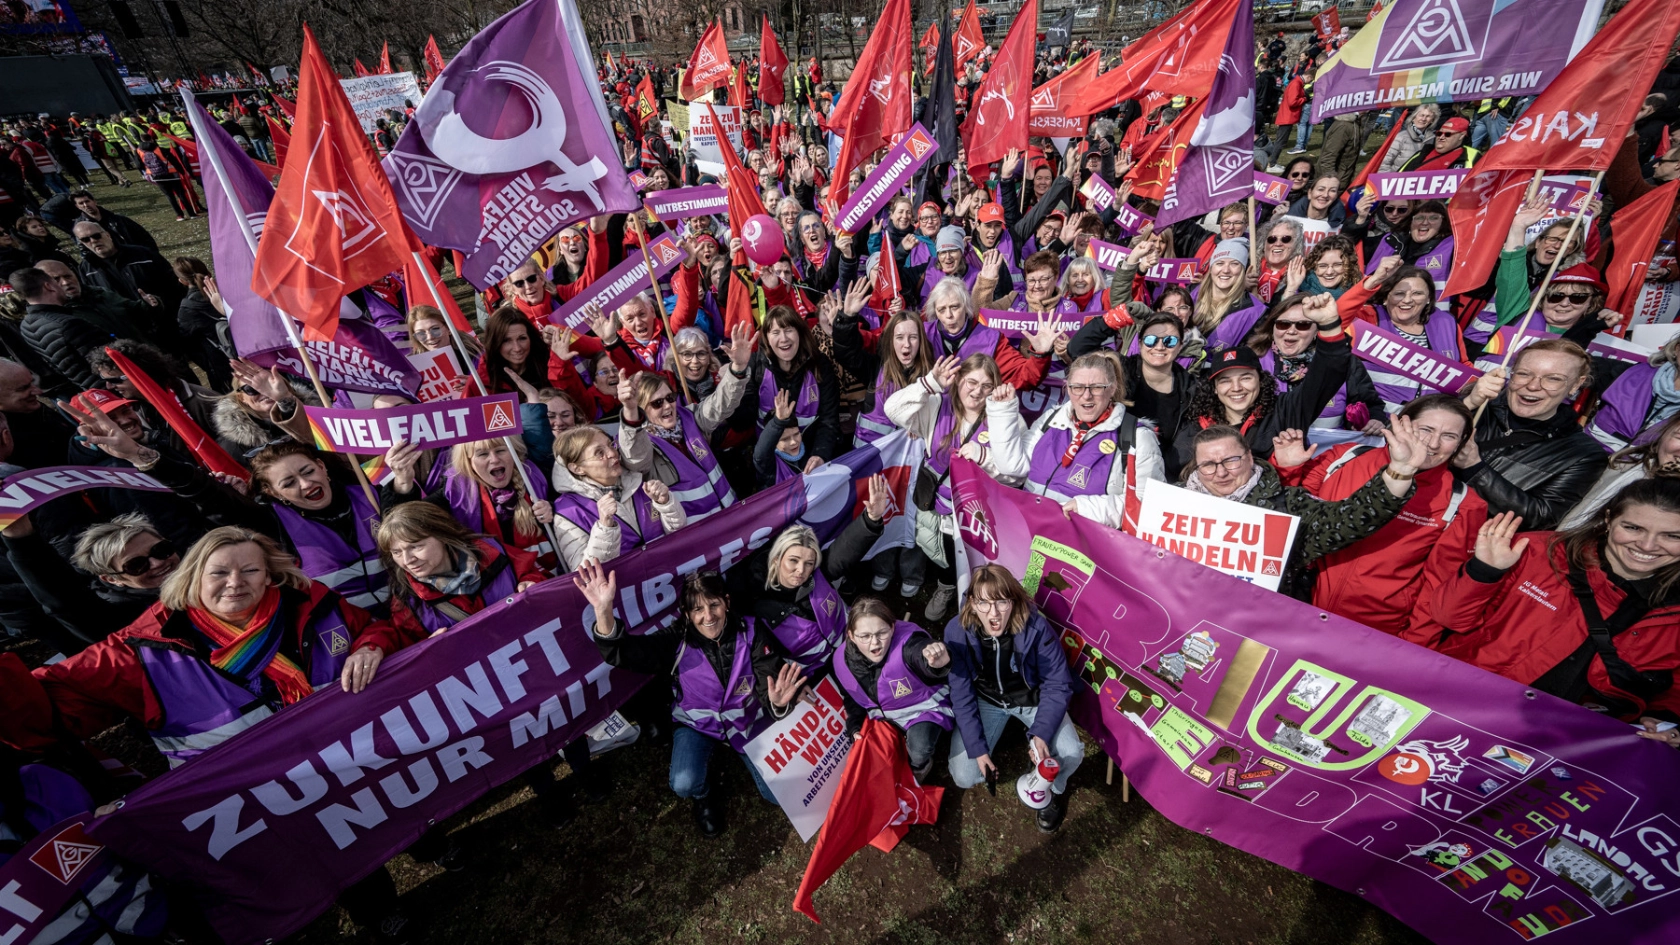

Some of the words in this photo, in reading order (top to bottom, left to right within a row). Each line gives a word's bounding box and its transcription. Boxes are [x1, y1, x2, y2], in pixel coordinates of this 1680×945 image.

[655, 195, 730, 215] MITBESTIMMUNG
[841, 153, 912, 232] MITBESTIMMUNG
[307, 349, 379, 382] STARK
[1357, 330, 1463, 388] VIELFALT
[322, 408, 470, 449] VIELFALT
[1160, 511, 1217, 540] ZEIT
[1224, 520, 1261, 546] ZU
[1517, 585, 1559, 612] Kaiserslautern
[1523, 580, 1532, 589] IG
[1531, 584, 1550, 599] Metall
[1288, 694, 1310, 710] Hanau
[181, 617, 572, 862] ZUKUNFT
[763, 698, 831, 775] HÄNDE
[800, 714, 844, 767] WEG
[1155, 730, 1176, 752] Stark
[1350, 730, 1370, 747] Fulda
[315, 735, 495, 850] NUR
[509, 661, 616, 749] MIT
[807, 764, 824, 784] VON
[1420, 787, 1462, 815] KL
[1493, 780, 1607, 848] FRAUEN
[1561, 823, 1665, 891] LANDAU
